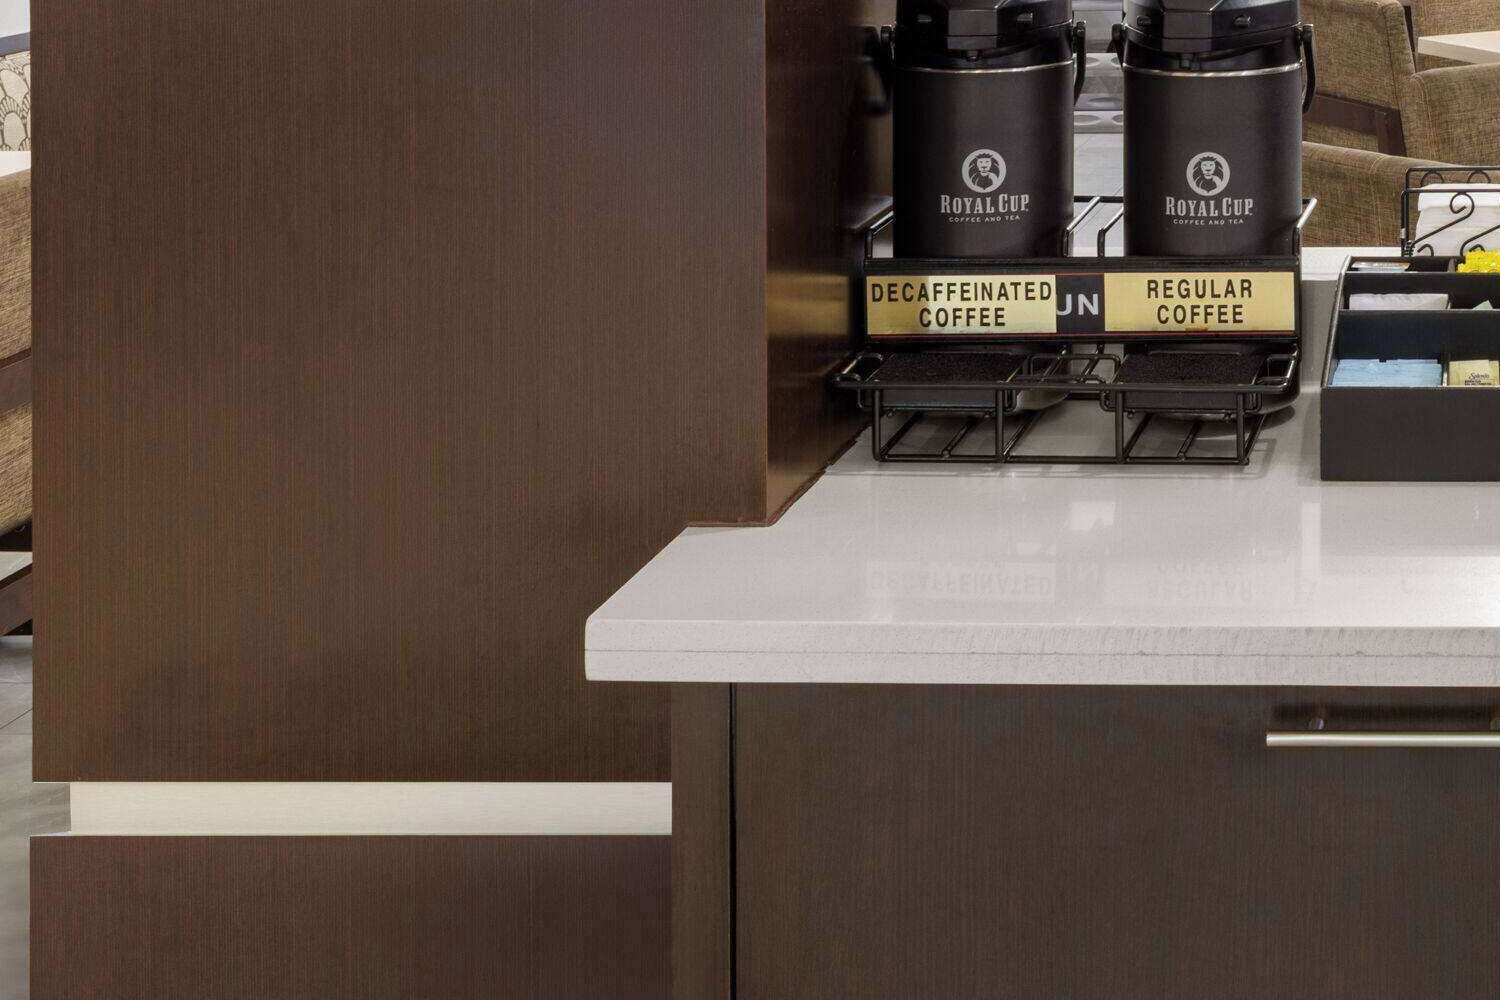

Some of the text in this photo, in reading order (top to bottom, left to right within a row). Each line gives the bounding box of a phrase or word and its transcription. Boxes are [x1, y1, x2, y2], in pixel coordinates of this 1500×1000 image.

[940, 193, 1030, 214] ROYAL CUP
[1165, 196, 1254, 217] ROYAL CUP
[871, 281, 1052, 302] DECAFFEINATED
[1146, 278, 1252, 299] REGULAR
[918, 307, 1006, 328] COFFEE
[1157, 304, 1244, 324] COFFEE
